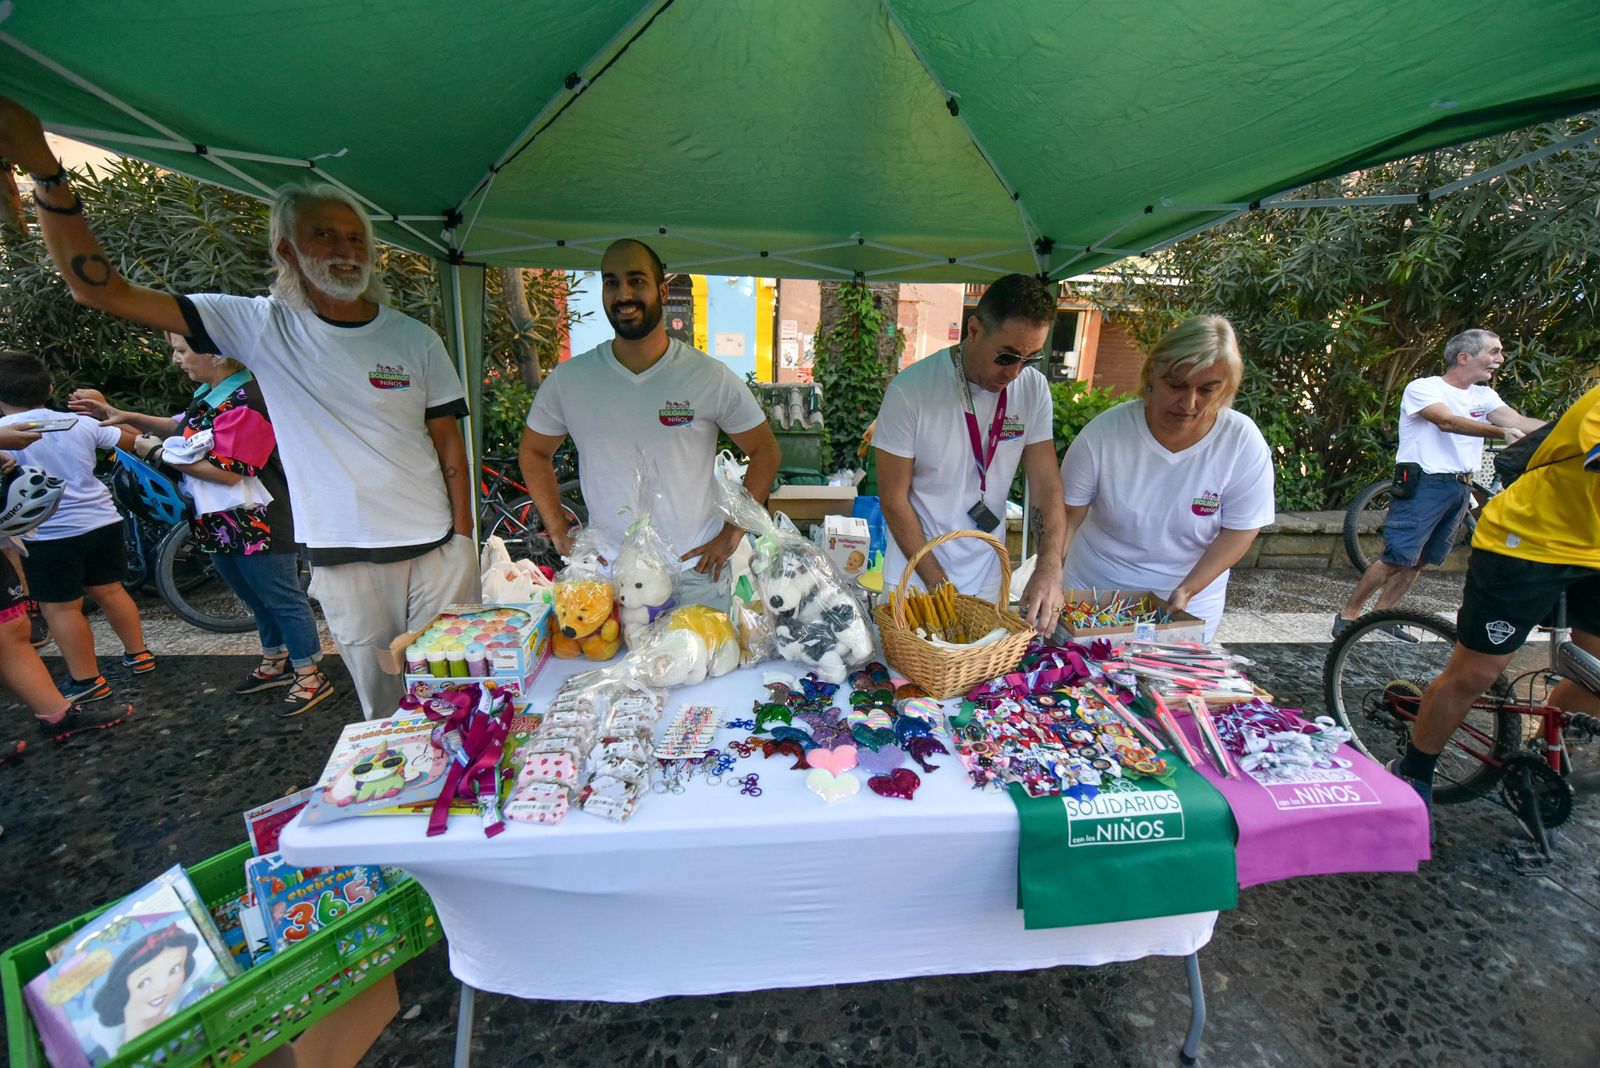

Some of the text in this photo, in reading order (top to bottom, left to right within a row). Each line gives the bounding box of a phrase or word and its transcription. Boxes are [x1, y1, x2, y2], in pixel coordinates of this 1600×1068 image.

[1253, 766, 1358, 783] SIDARIOS
[1067, 794, 1179, 817] SOLIDARIOS
[1293, 784, 1360, 804] NIÑOS
[1097, 818, 1165, 841] NIÑOS
[283, 877, 377, 942] 365
